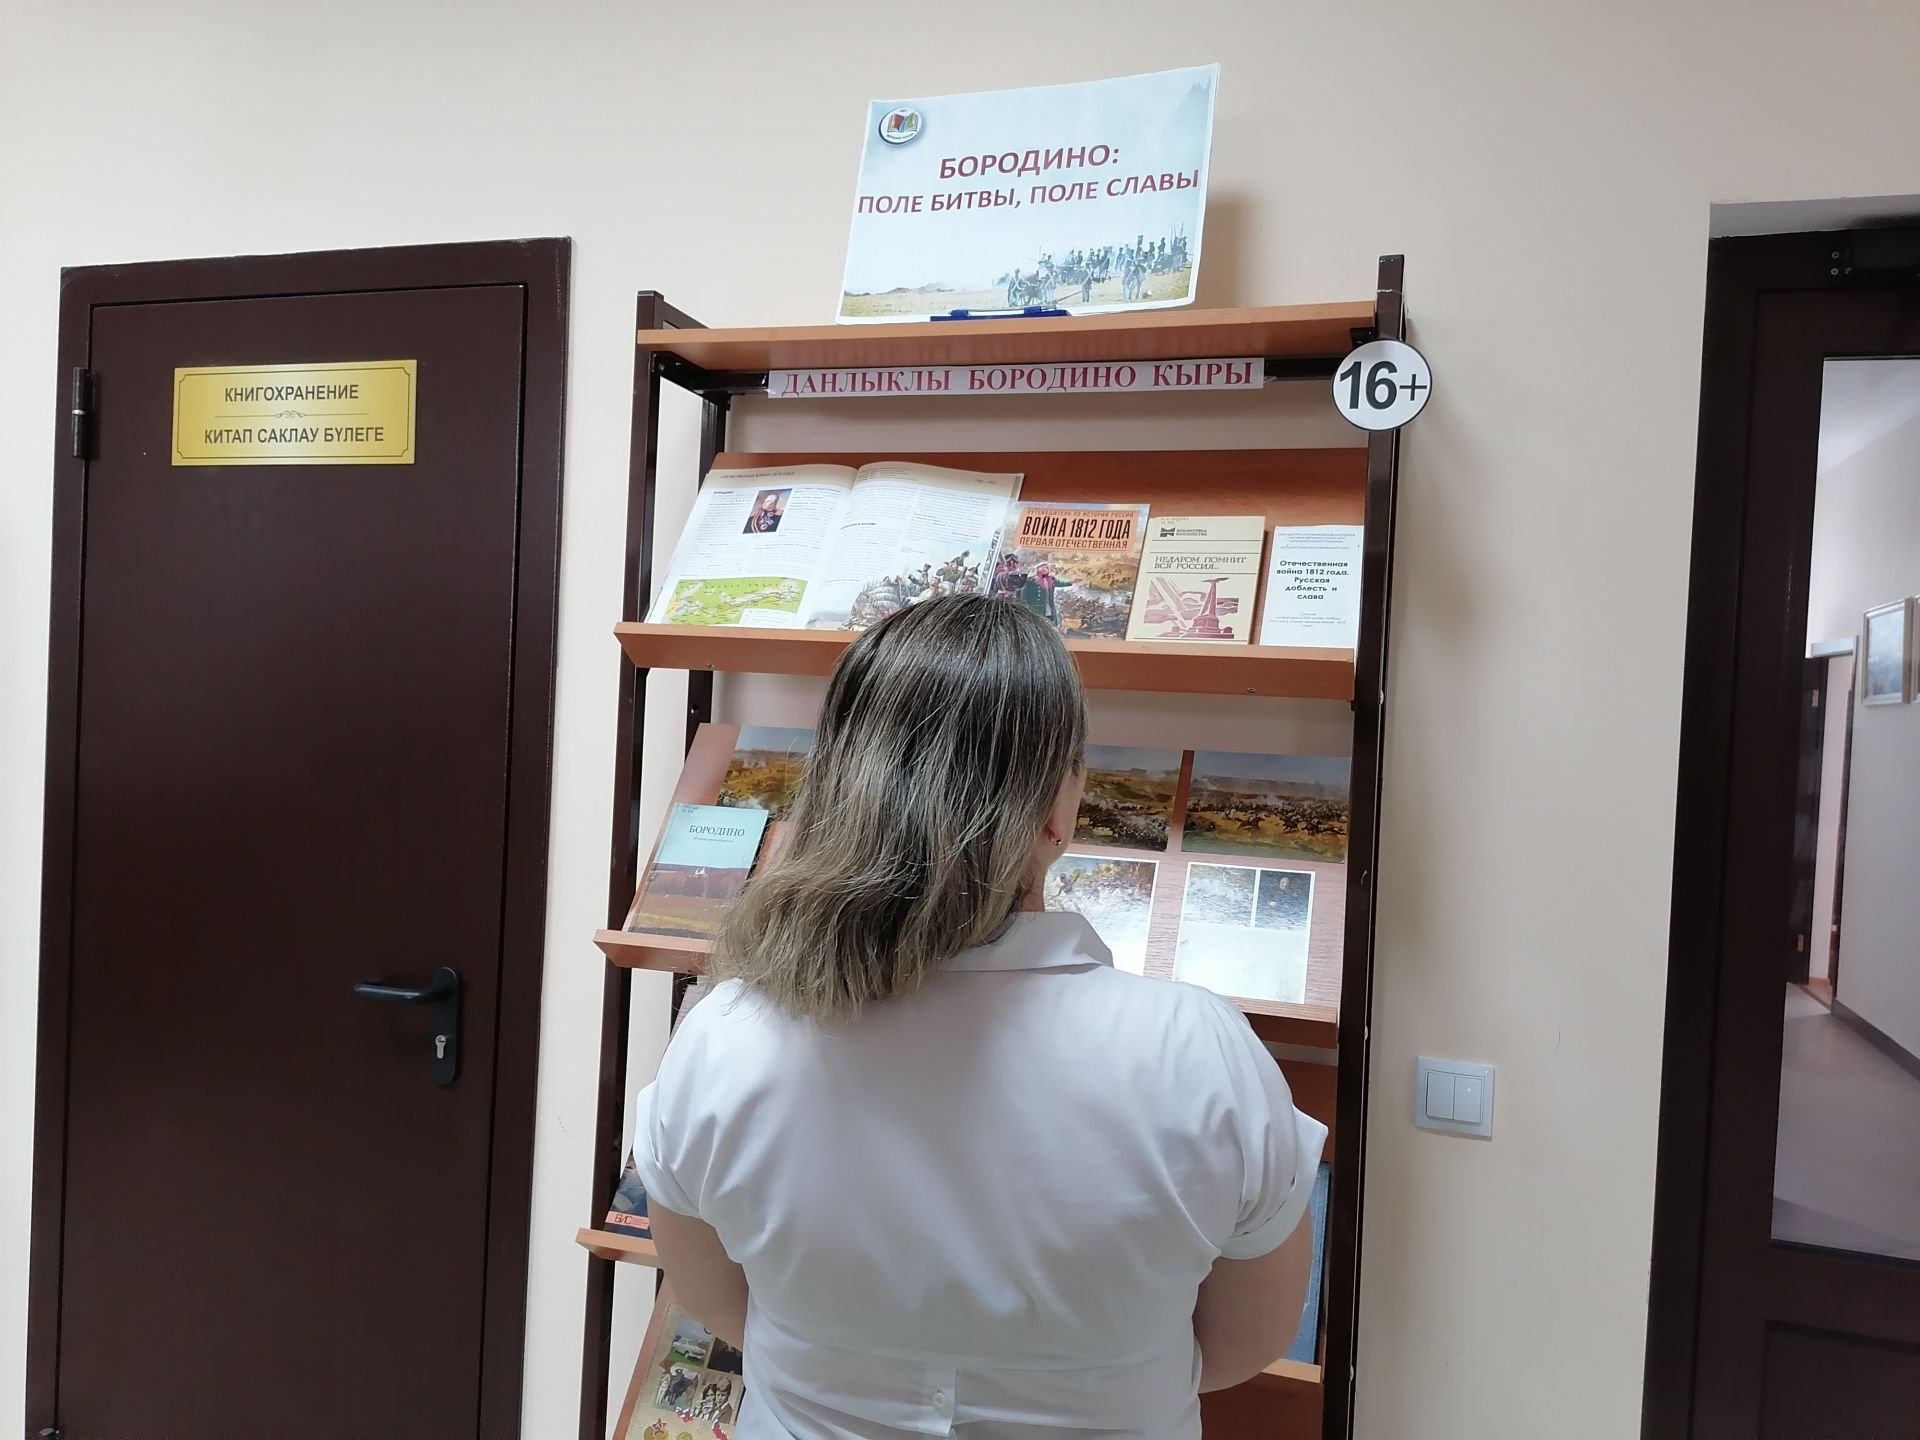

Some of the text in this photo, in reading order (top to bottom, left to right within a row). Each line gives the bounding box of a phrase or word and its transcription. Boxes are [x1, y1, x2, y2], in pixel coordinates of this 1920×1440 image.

[939, 144, 1120, 179] БОРОДИНО:
[858, 169, 1199, 214] ПОЛЕ БИТВЫ, ПОЛЕ СЛАВЫ
[781, 361, 1257, 399] ДАНЛЫКЛЫ БОРОДИНО КЫРЫ
[1339, 361, 1428, 410] 16+
[224, 384, 359, 403] КНИГОХРАНЕНИЕ
[204, 428, 252, 444] КИТАП
[257, 427, 319, 444] САКЛАУ
[1022, 516, 1131, 540] ВОЙНА 1812 ГОДА
[1019, 537, 1128, 549] ПЕРВАЯ ОТЕЧЕСТВЕННАЯ
[1155, 556, 1200, 564] НЕДАРОМ
[1294, 576, 1330, 584] Русская
[688, 825, 746, 837] БОРОДИНО
